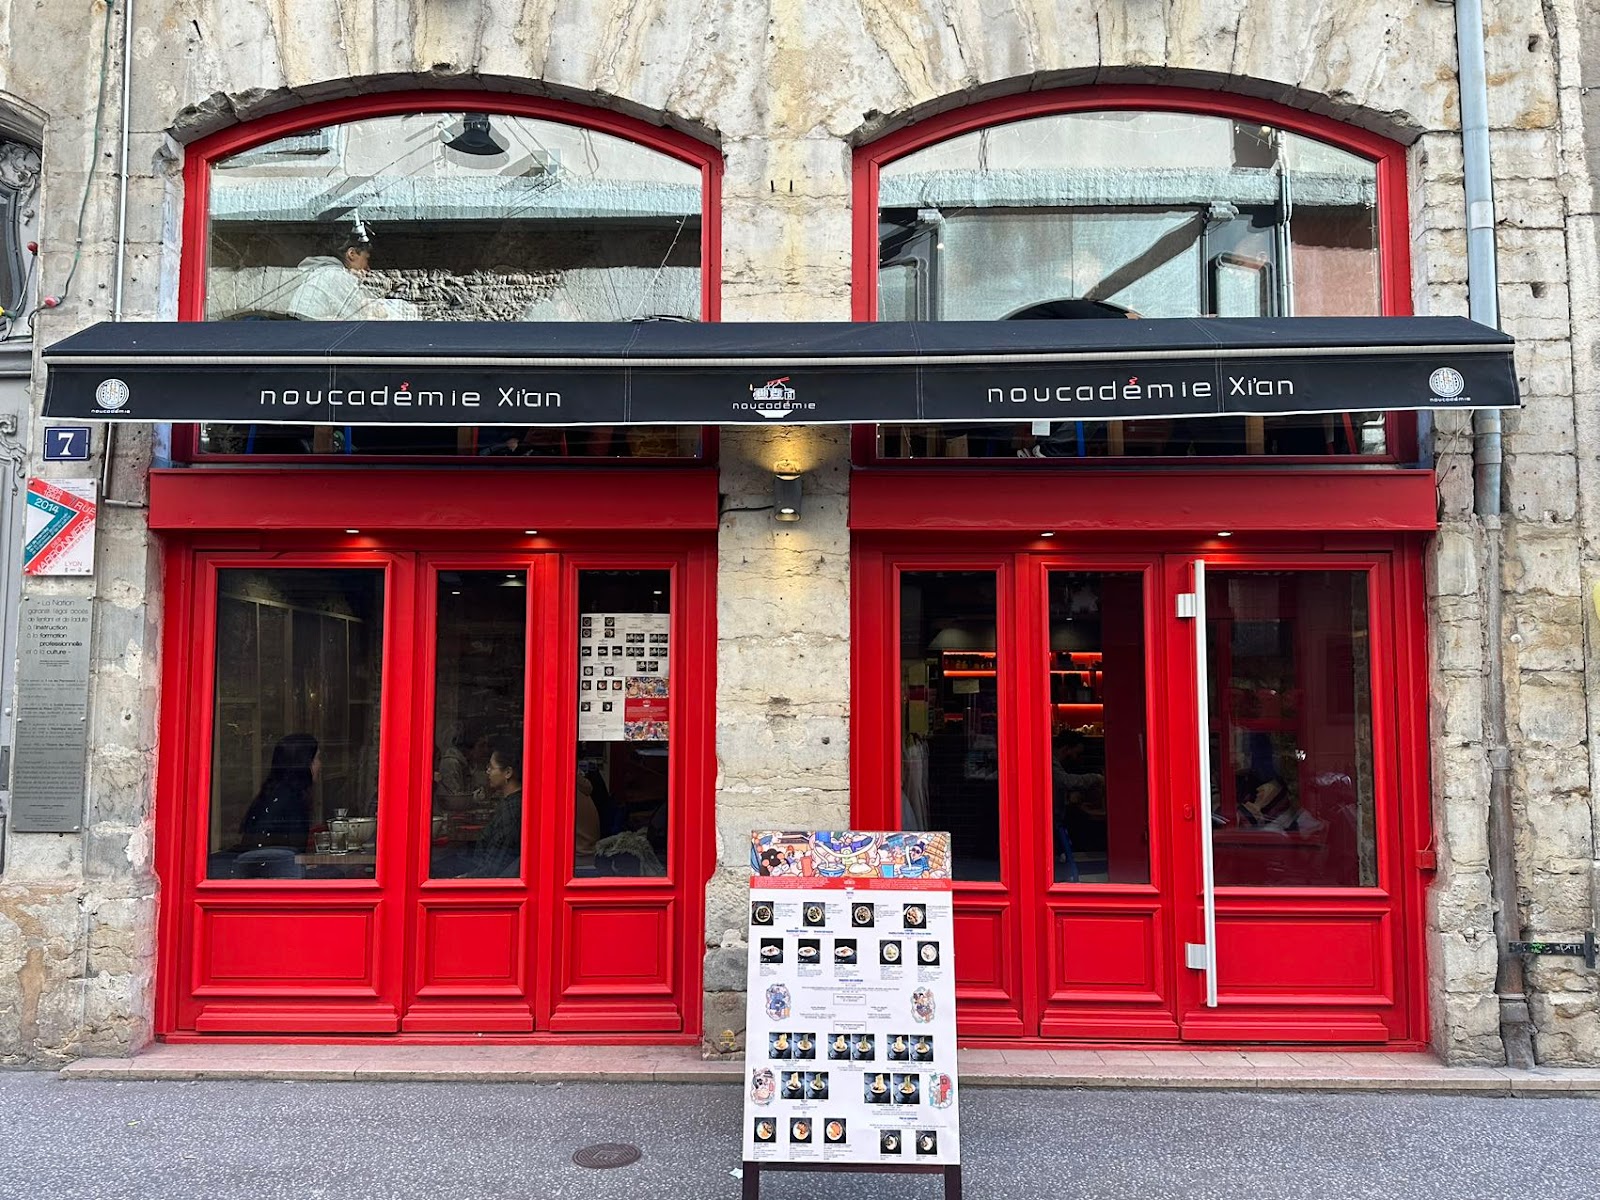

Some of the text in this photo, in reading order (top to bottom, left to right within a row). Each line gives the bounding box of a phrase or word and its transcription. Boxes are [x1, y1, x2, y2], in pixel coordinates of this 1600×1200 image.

[260, 382, 562, 408] noucadémie Xi'an
[988, 376, 1294, 403] noucadémie Xi'an
[732, 400, 816, 410] noucadémie
[58, 432, 74, 456] 7
[34, 498, 59, 514] 2014
[74, 500, 96, 516] RUE
[32, 516, 90, 574] MARRONNIERS
